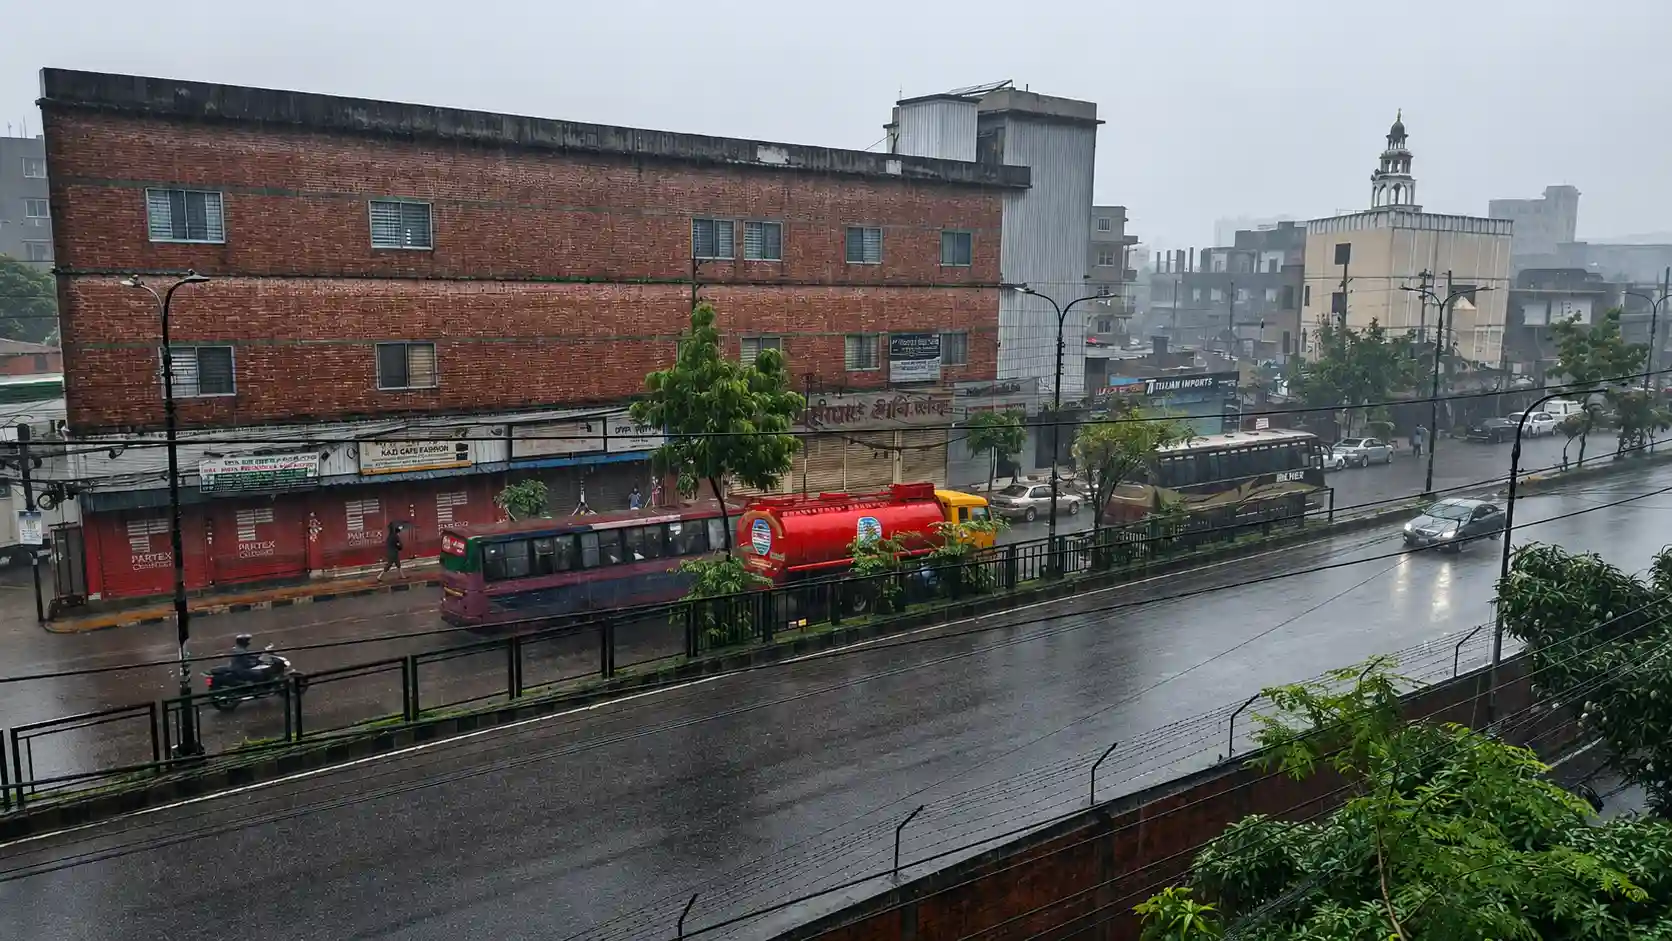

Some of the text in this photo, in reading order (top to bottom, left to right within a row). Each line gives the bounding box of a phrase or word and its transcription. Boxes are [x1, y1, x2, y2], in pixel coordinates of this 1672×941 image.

[1181, 377, 1213, 389] IMPORTS
[237, 540, 276, 551] PARTEX
[131, 551, 172, 564] PARTEX
